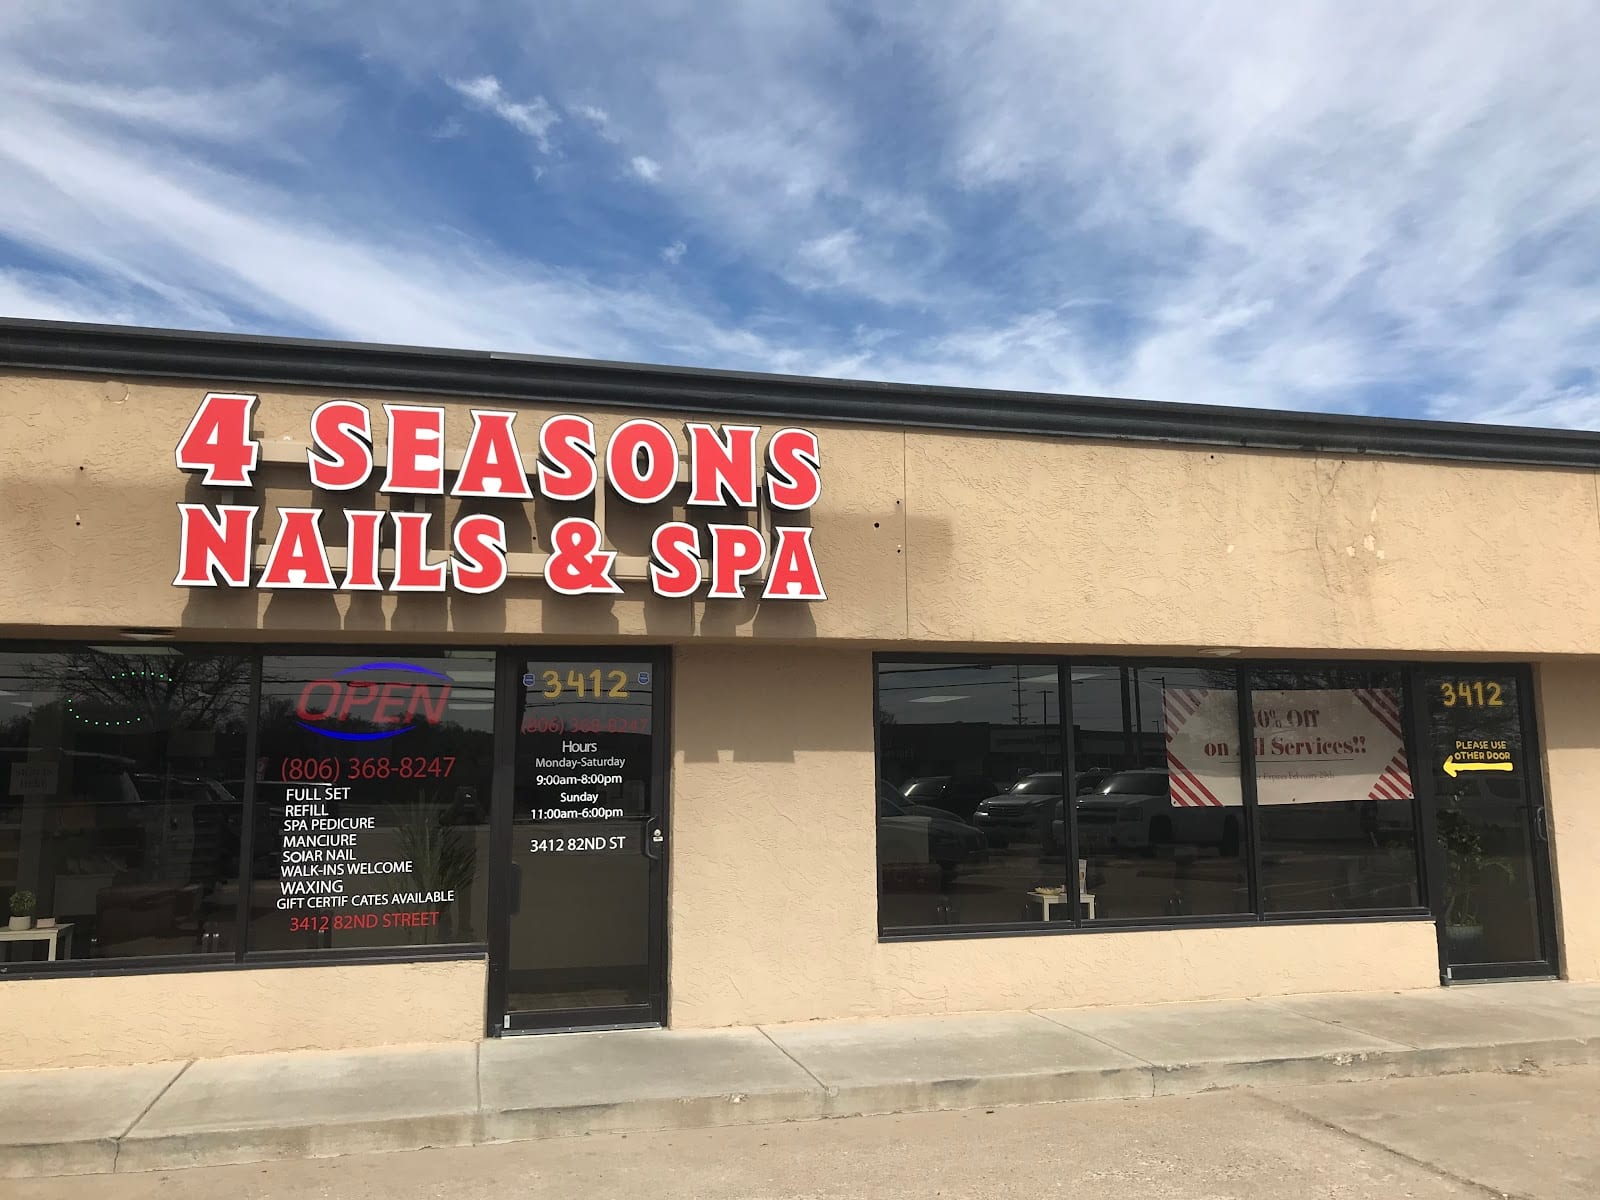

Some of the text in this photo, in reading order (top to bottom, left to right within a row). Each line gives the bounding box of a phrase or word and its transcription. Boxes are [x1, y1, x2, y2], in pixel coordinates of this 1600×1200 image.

[174, 392, 822, 511] 4 SEASONS
[173, 502, 828, 600] NAILS & SPA
[543, 669, 629, 698] 3412
[295, 679, 452, 724] OPEN
[1441, 681, 1504, 707] 3412
[562, 740, 598, 753] Hours
[1204, 742, 1229, 757] on
[1271, 736, 1367, 756] Services!!
[1455, 740, 1507, 750] PLEASE USE
[535, 757, 626, 769] Monday-Saturday
[1454, 751, 1511, 760] OTHER DOOR
[281, 756, 456, 783] (806) 368-8247
[536, 773, 623, 787] 9:00am-8:00pm
[286, 787, 351, 801] FULL SET
[560, 792, 599, 804] Sunday
[285, 804, 329, 817] REFILL
[531, 807, 624, 821] 11:00am-6:00pm
[283, 817, 375, 832] SPA PEDICURE
[283, 833, 357, 848] MANCIURE
[530, 836, 626, 853] 3412 82ND ST
[326, 849, 357, 861] NAIL
[280, 861, 413, 878] WALK-INS WELCOME
[280, 880, 344, 895] WAXING
[276, 897, 305, 910] GIFT
[391, 890, 455, 905] AVAILABLE
[290, 911, 440, 931] 3412 82ND STREET
